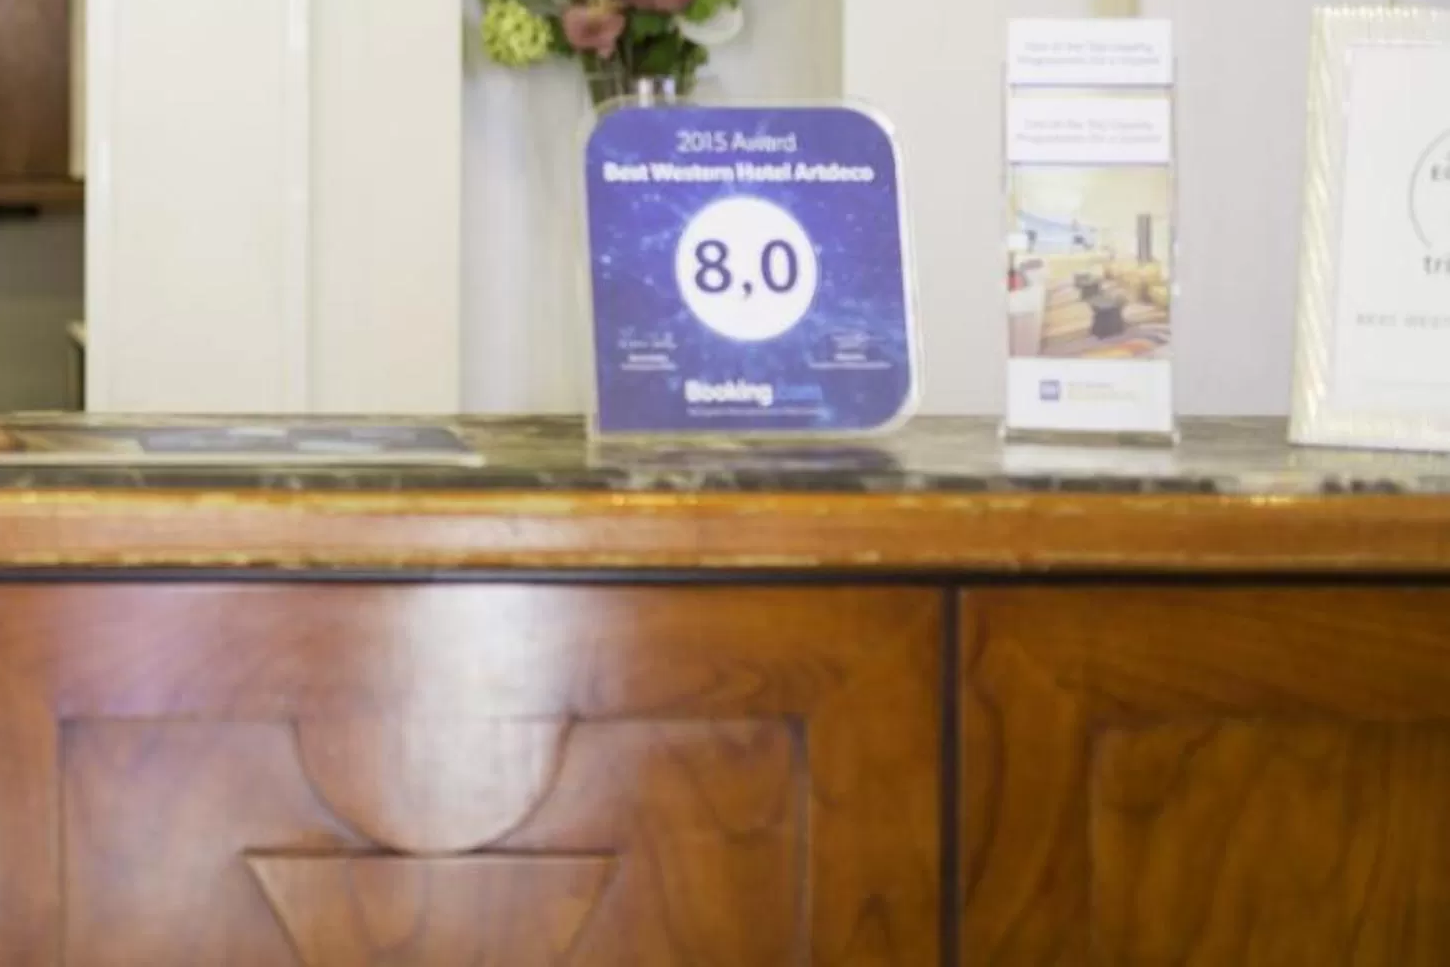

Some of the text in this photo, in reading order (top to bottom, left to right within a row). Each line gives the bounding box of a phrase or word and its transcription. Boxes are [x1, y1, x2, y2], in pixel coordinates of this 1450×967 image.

[676, 132, 797, 153] 2015 Award
[603, 162, 648, 182] Best
[650, 162, 734, 182] Western
[735, 162, 792, 181] Hotel
[693, 239, 798, 296] 8,0
